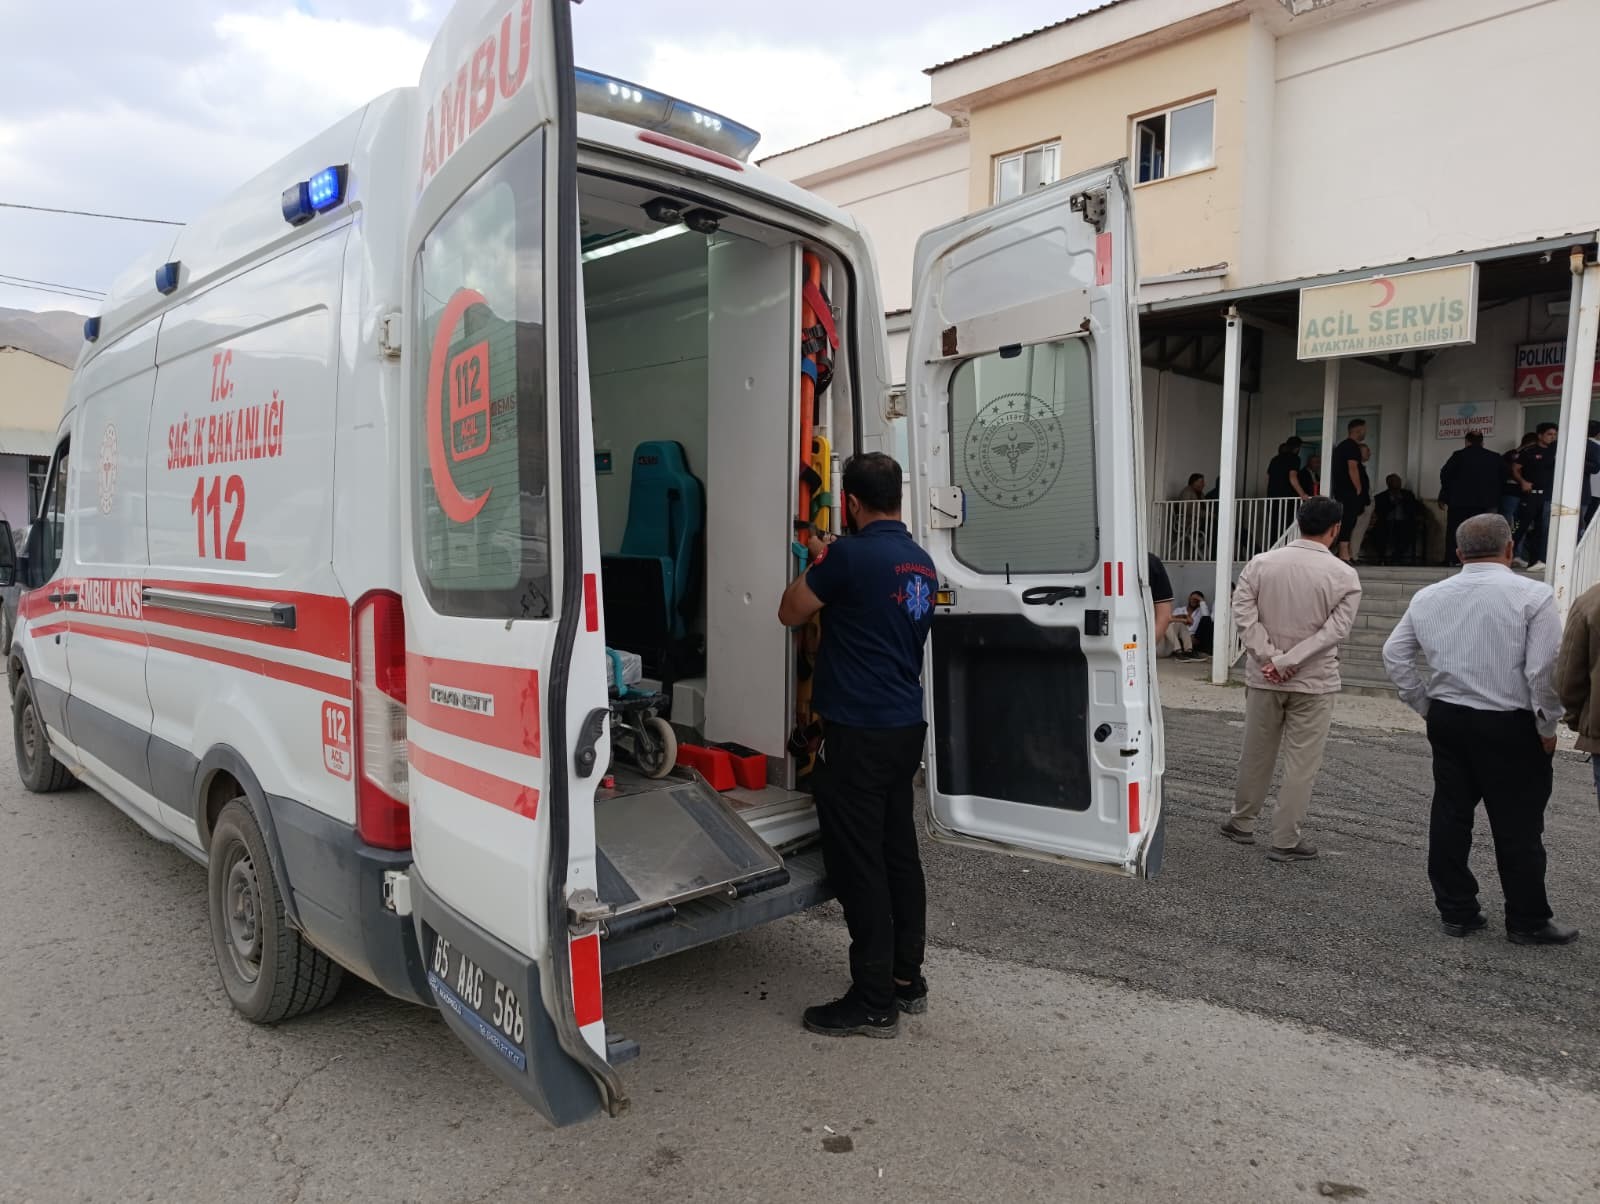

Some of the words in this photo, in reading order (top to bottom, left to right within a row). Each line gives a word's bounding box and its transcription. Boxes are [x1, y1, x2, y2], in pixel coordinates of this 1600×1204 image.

[1305, 309, 1359, 340] ACİL
[1369, 297, 1464, 332] SERVİS
[1311, 336, 1364, 354] AYAKTAN
[1368, 332, 1408, 348] HASTA
[455, 355, 481, 408] 112
[167, 411, 206, 470] SAĞLIK
[207, 388, 285, 464] BAKANLIĞI
[191, 473, 247, 562] 112
[79, 579, 141, 619] AMBULANS
[431, 687, 492, 712] TRANSIT
[326, 707, 347, 744] 112
[434, 934, 450, 979] 65
[457, 954, 484, 1011] AAG
